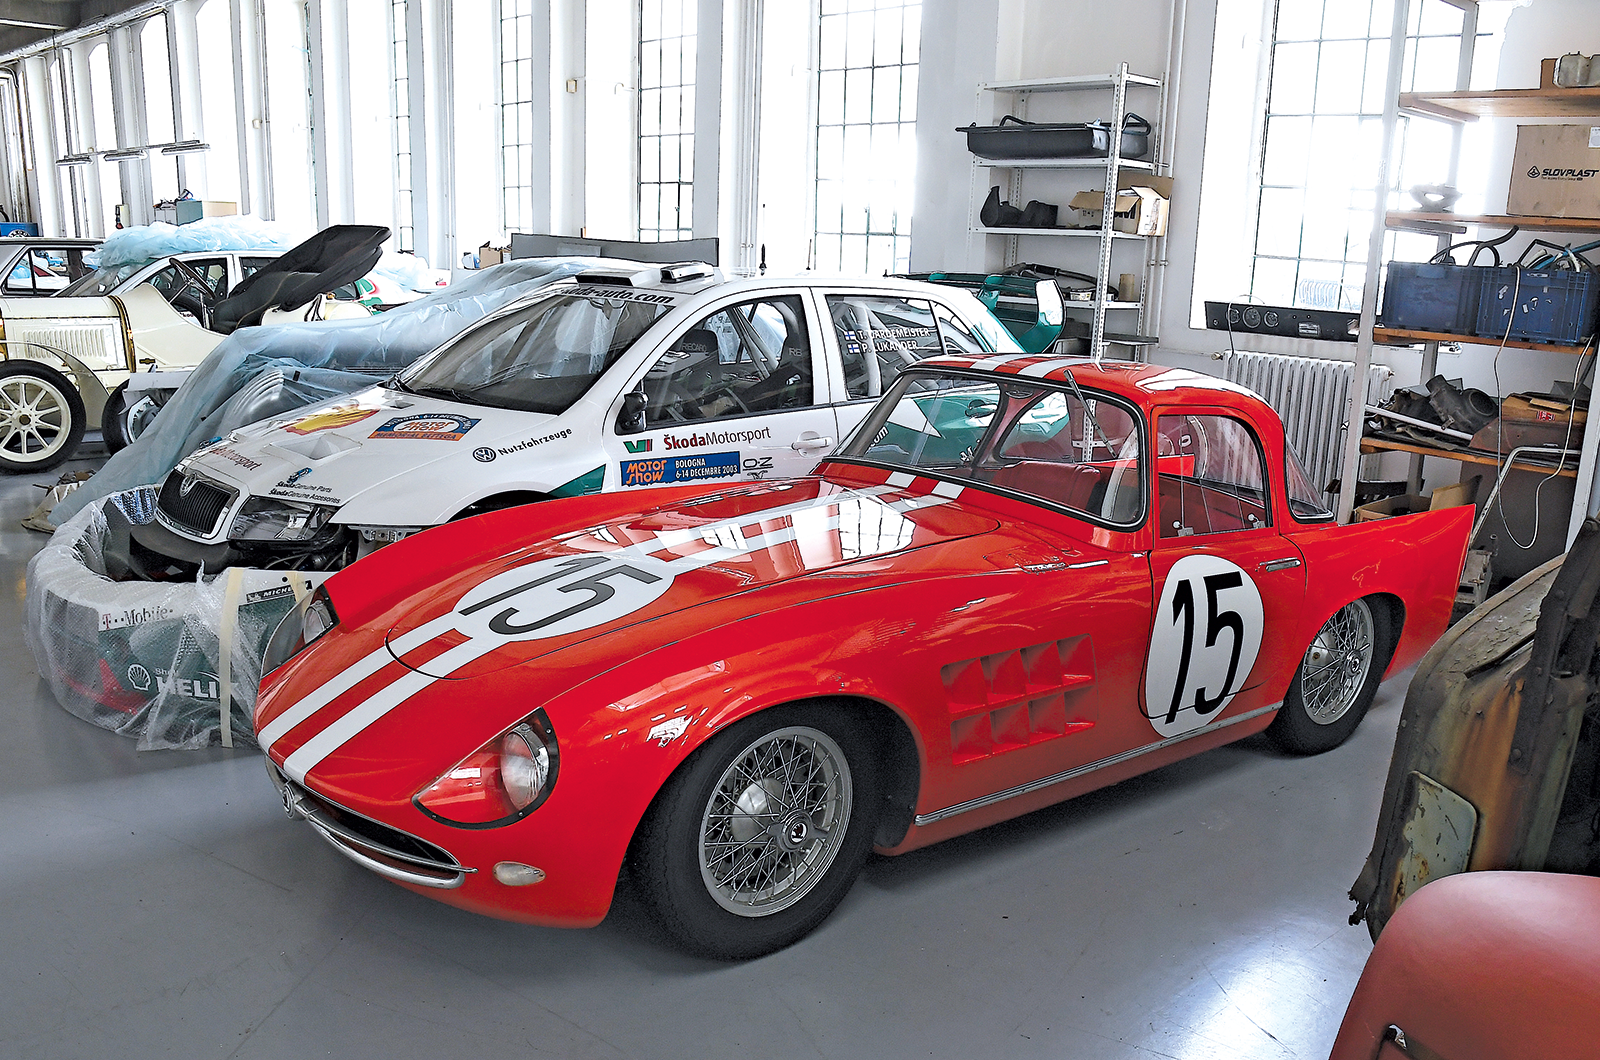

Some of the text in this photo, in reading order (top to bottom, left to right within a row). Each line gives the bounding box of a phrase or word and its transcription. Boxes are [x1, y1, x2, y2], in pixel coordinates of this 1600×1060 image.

[1541, 168, 1599, 178] SLOVPLAST
[497, 427, 573, 456] Nutzfahrzeuge
[675, 458, 706, 469] BOLOGNA
[675, 464, 738, 479] 6-14 DECEMBRE 2003
[458, 555, 663, 635] 15
[1164, 571, 1244, 725] 15
